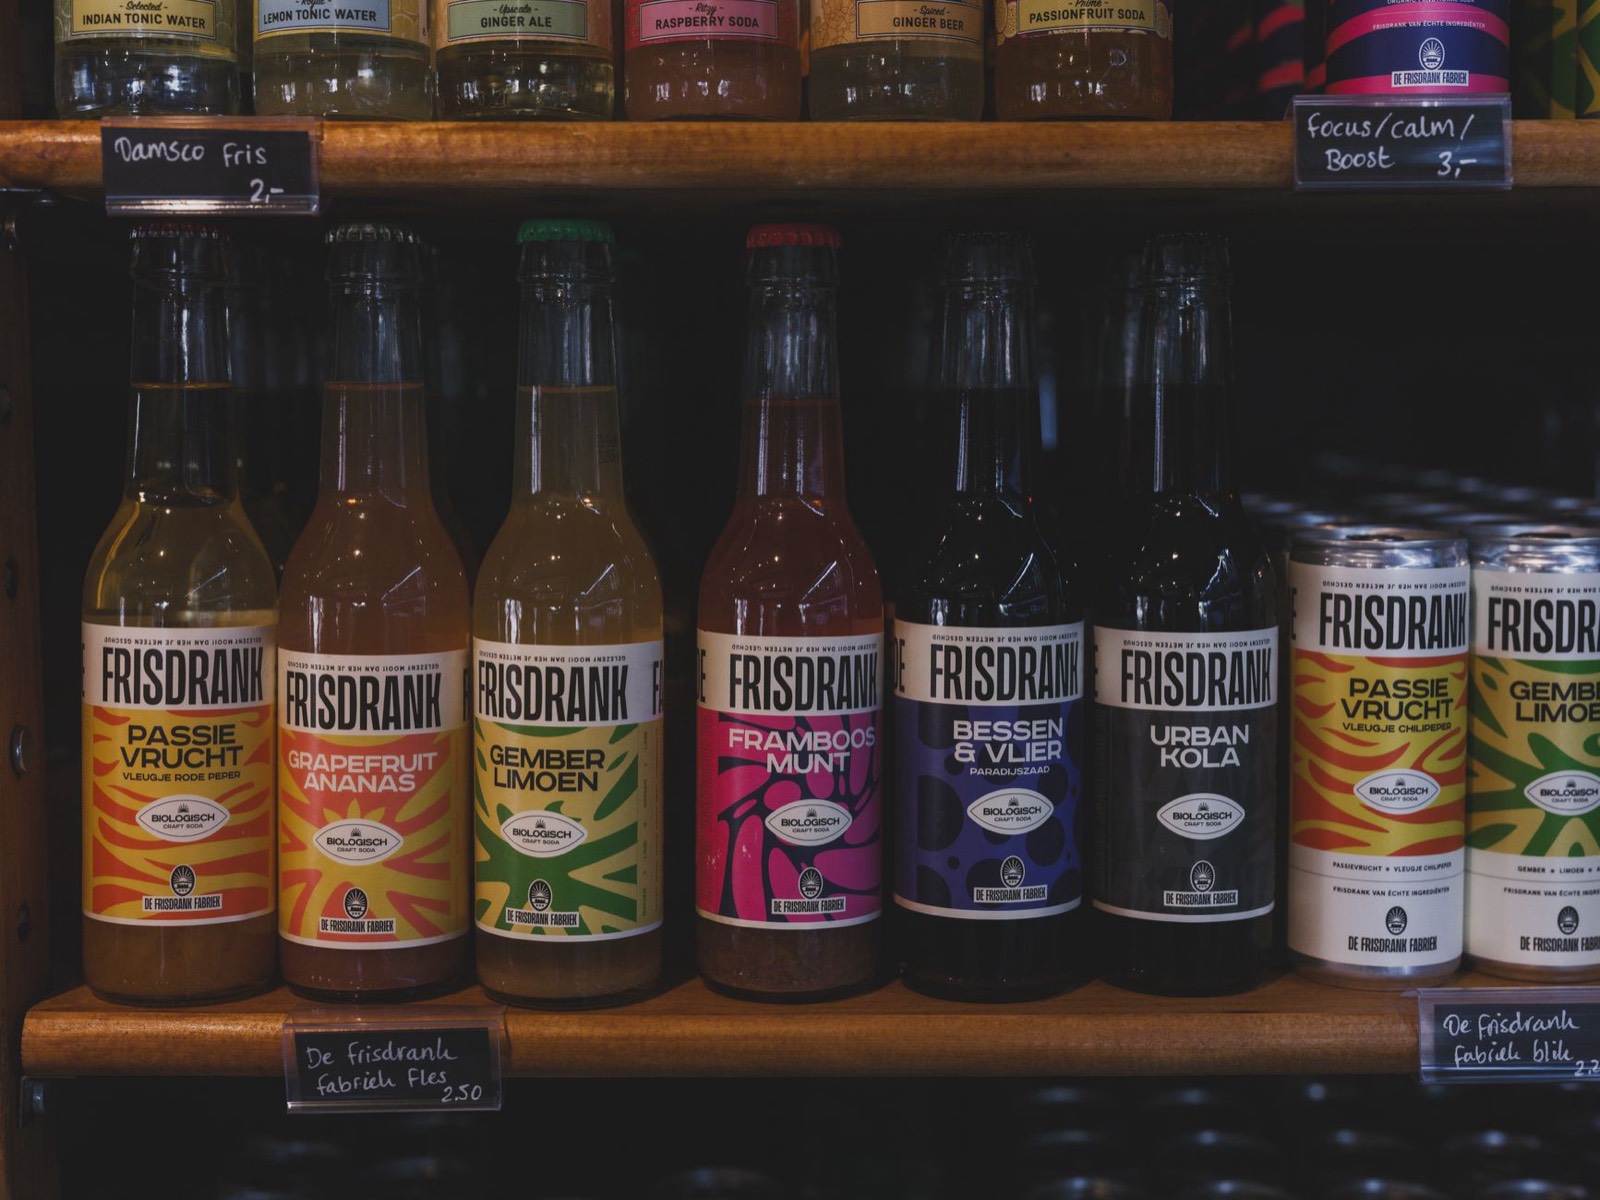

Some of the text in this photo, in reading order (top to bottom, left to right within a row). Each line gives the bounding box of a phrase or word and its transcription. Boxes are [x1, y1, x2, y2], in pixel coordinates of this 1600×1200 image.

[125, 1, 162, 11] Selected
[695, 3, 717, 16] Ritzy
[919, 5, 945, 16] Spiced
[83, 13, 206, 29] INDIAN TONIC WATER
[263, 9, 377, 24] LEMON TONIC WATER
[481, 16, 552, 28] GINGER ALE
[656, 16, 759, 30] RASPBERRY SODA
[893, 17, 964, 31] GINGER BEER
[1029, 8, 1146, 24] PASSIONFRUIT SODA
[1372, 21, 1408, 31] FRISDRANK
[1394, 71, 1467, 85] DE FRISDRANK FABRIEK
[114, 136, 267, 168] Damsco Fris
[1325, 145, 1395, 172] Boost
[1319, 592, 1467, 651] FRISDRANK
[1487, 597, 1600, 653] FRISDR
[310, 663, 335, 671] METEEN
[930, 641, 1079, 701] FRISDRANK
[102, 646, 263, 705] FRISDRANK
[729, 652, 878, 711] FRISDRANK
[1121, 647, 1271, 706] FRISDRANK
[478, 660, 629, 722] FRISDRANK
[1350, 677, 1449, 699] PASSIE
[286, 670, 442, 730] FRISDRANK
[1341, 698, 1454, 721] VRUCHT
[128, 724, 236, 746] PASSIE
[953, 717, 1063, 741] BESSEN
[1150, 724, 1249, 746] URBAN
[1342, 722, 1452, 733] VLEUGJE CHILIPEPER
[728, 726, 875, 752] FRAMBOOS
[120, 746, 244, 769] VRUCHT
[490, 745, 605, 770] GEMBER
[954, 740, 1062, 763] & VLIER
[1160, 747, 1241, 768] KOLA
[288, 750, 439, 774] GRAPEFRUIT
[766, 751, 850, 773] MUNT
[123, 771, 241, 782] VLEUGJE RODE PEPER
[970, 766, 1050, 776] PARADIJSZAAD
[303, 772, 416, 793] ANANAS
[494, 767, 599, 792] LIMOEN
[1369, 786, 1429, 796] BIOLOGISCH
[1540, 788, 1599, 797] BIOLOGISCH
[151, 813, 215, 823] BIOLOGISCH
[983, 806, 1042, 816] BIOLOGISCH
[1172, 811, 1232, 820] BIOLOGISCH
[781, 817, 840, 827] BIOLOGISCH
[512, 828, 572, 838] BIOLOGISCH
[326, 837, 388, 846] BIOLOGISCH
[1332, 861, 1382, 872] PASSIEVRUCHT
[1393, 864, 1423, 872] VLEUGJE
[976, 886, 1046, 901] DE FRISDRANK FABRIEK
[1166, 891, 1237, 905] DE FRISDRANK FABRIEK
[1333, 886, 1371, 896] FRISDRANK
[1373, 888, 1386, 897] VAN
[1387, 886, 1410, 897] ÉCHTE
[1503, 887, 1541, 896] FRISDRANK
[144, 895, 221, 910] DE FRISDRANK FABRIEK
[773, 898, 845, 912] DE FRISDRANK FABRIEK
[507, 909, 577, 925] DE FRISDRANK FABRIEK
[321, 919, 394, 932] DE FRISDRANK FABRIEK
[1348, 935, 1437, 952] DE FRISDRANK FABRIEK
[1520, 936, 1531, 950] DE
[1533, 937, 1579, 952] FRISDRANK
[1443, 1013, 1472, 1037] De
[306, 1045, 335, 1069] De
[441, 1083, 482, 1103] 2.50
